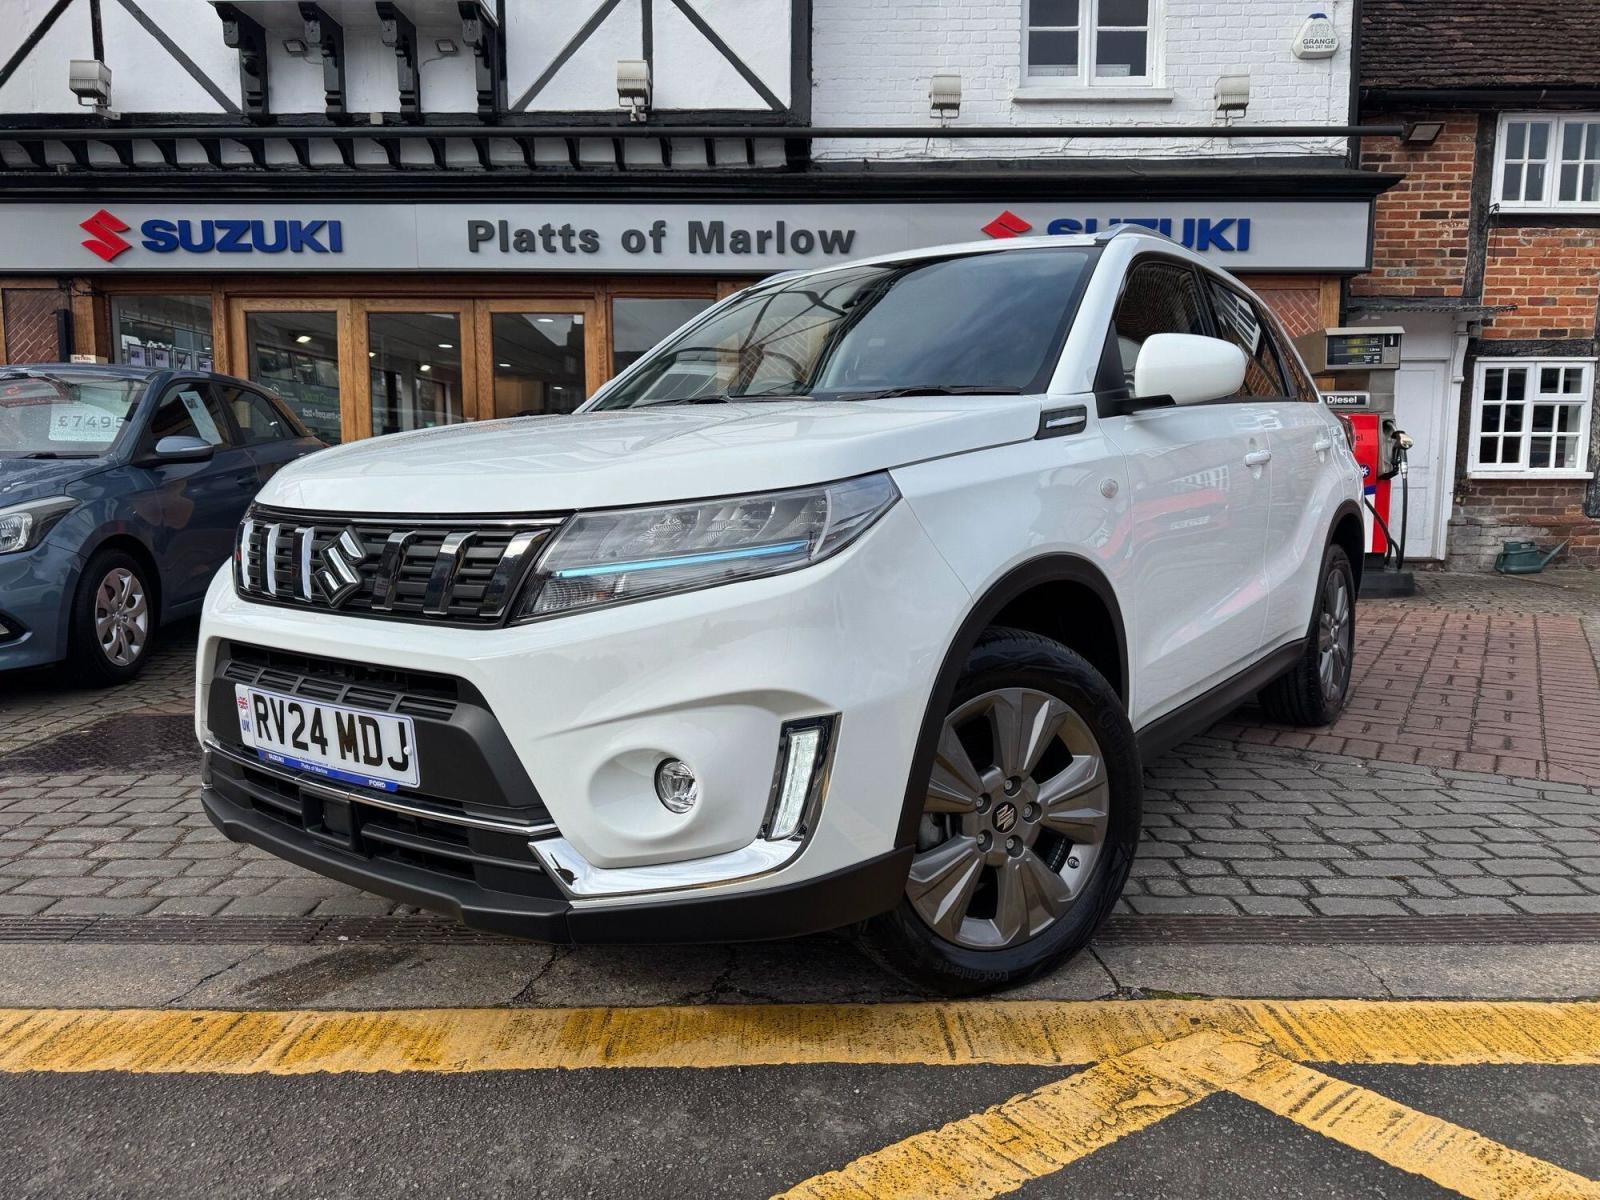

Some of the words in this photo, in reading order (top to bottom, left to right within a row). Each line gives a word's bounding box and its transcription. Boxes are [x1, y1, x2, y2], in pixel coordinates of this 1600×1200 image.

[141, 219, 343, 253] SUZUKI
[467, 219, 600, 253] Platts
[621, 220, 666, 253] of
[688, 220, 856, 254] Marlow
[1327, 396, 1357, 404] Diesel
[58, 415, 125, 429] £7495
[241, 719, 251, 732] UK
[252, 693, 328, 755] RV24
[335, 711, 409, 772] MDJ
[368, 779, 386, 788] FORD
